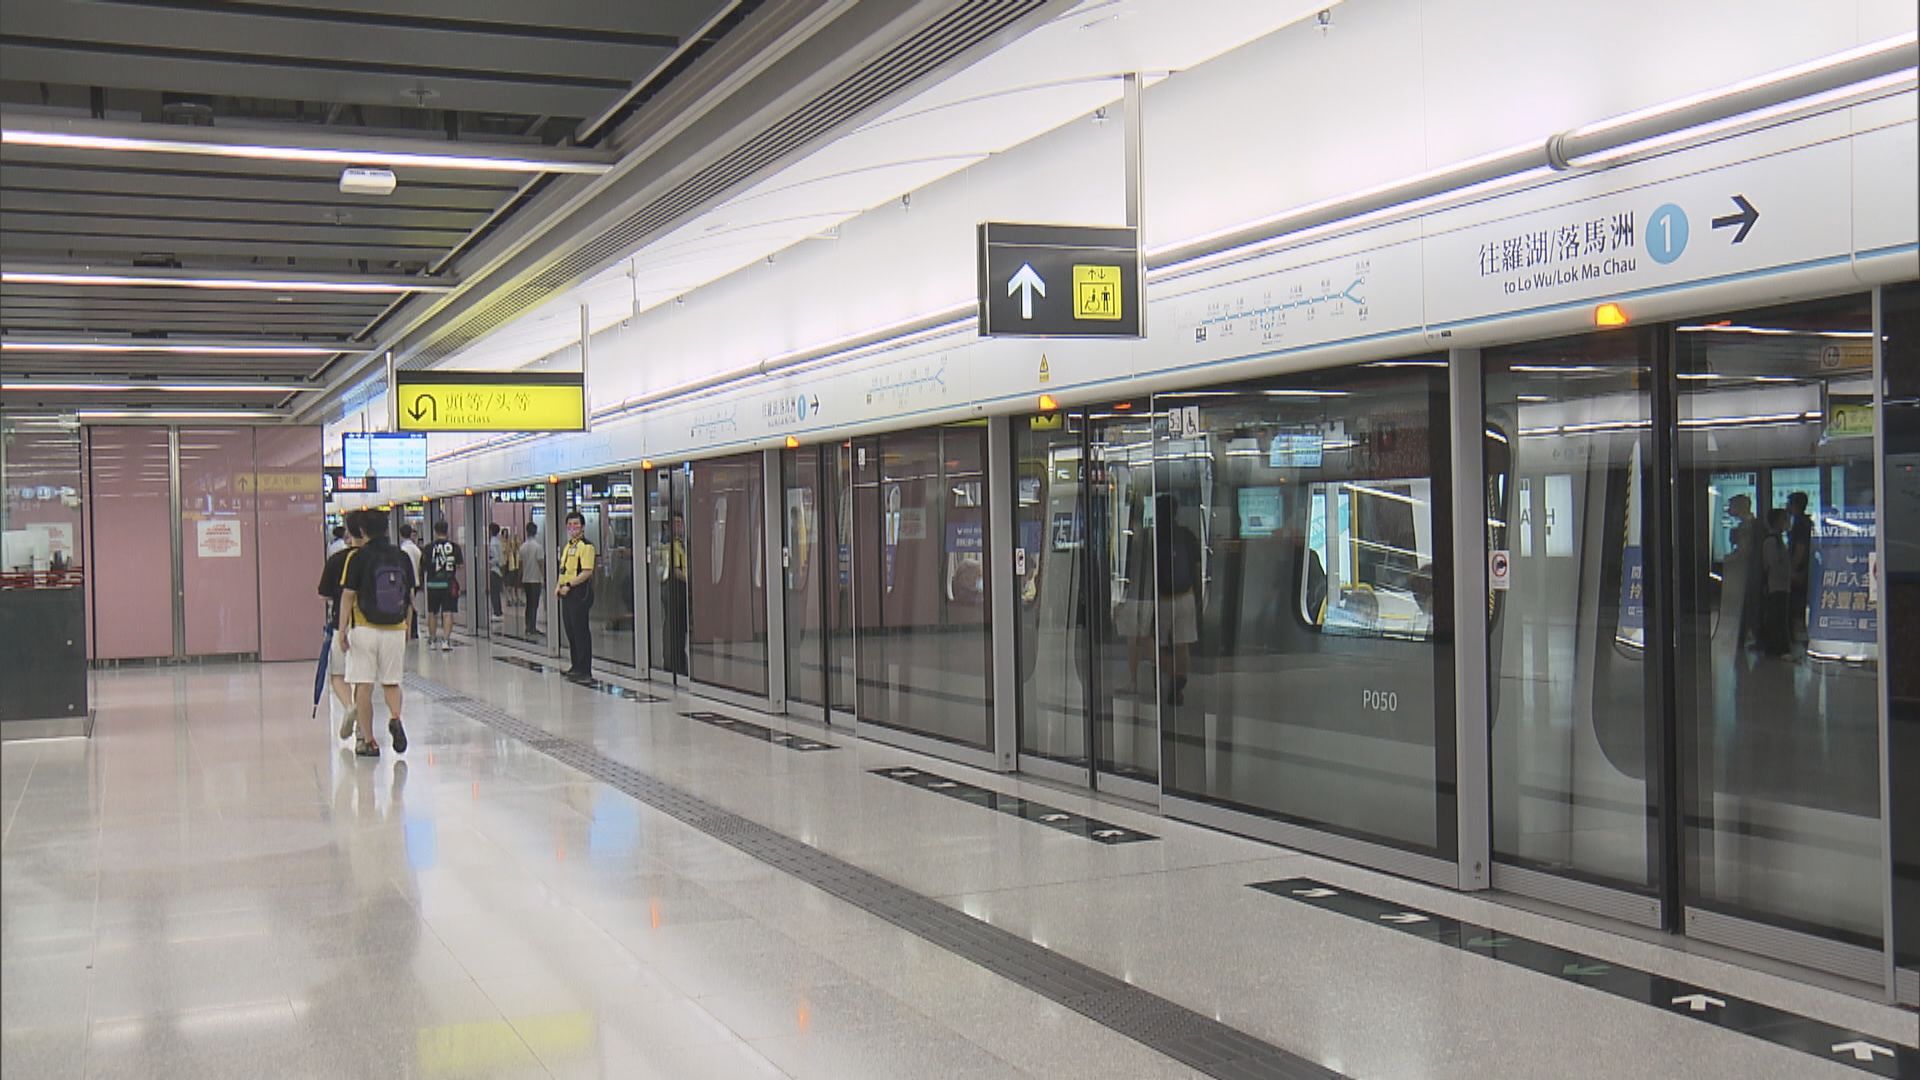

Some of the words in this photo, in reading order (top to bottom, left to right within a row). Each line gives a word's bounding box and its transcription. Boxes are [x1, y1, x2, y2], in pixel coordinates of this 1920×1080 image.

[1479, 211, 1635, 277] 往羅湖/落馬洲
[1660, 214, 1672, 253] 1
[1504, 280, 1516, 294] to
[1518, 276, 1531, 292] Lo
[1533, 269, 1579, 290] Wu/Lok
[1581, 263, 1600, 285] Ma
[1603, 257, 1636, 275] Chau
[445, 414, 464, 423] First
[467, 414, 491, 424] Class
[1363, 690, 1398, 712] P050
